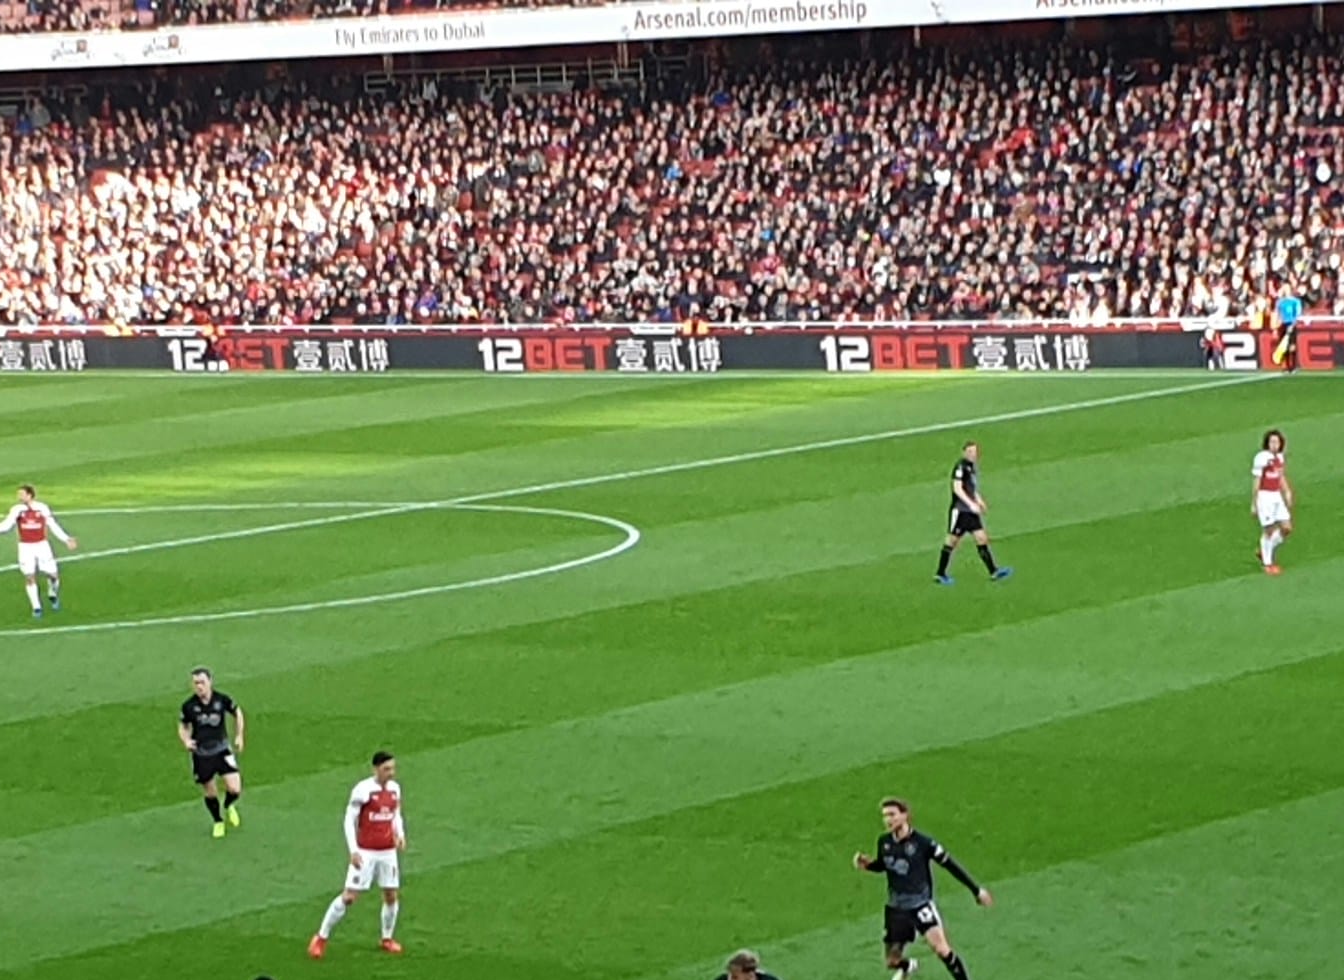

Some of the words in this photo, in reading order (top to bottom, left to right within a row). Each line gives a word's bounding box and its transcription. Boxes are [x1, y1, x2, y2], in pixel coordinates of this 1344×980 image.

[633, 1, 867, 30] Arsenal.com/membership
[360, 26, 419, 46] Emirates
[424, 25, 438, 42] to
[443, 22, 485, 41] Dubai
[478, 337, 611, 371] 12BET
[820, 335, 969, 371] 12BET
